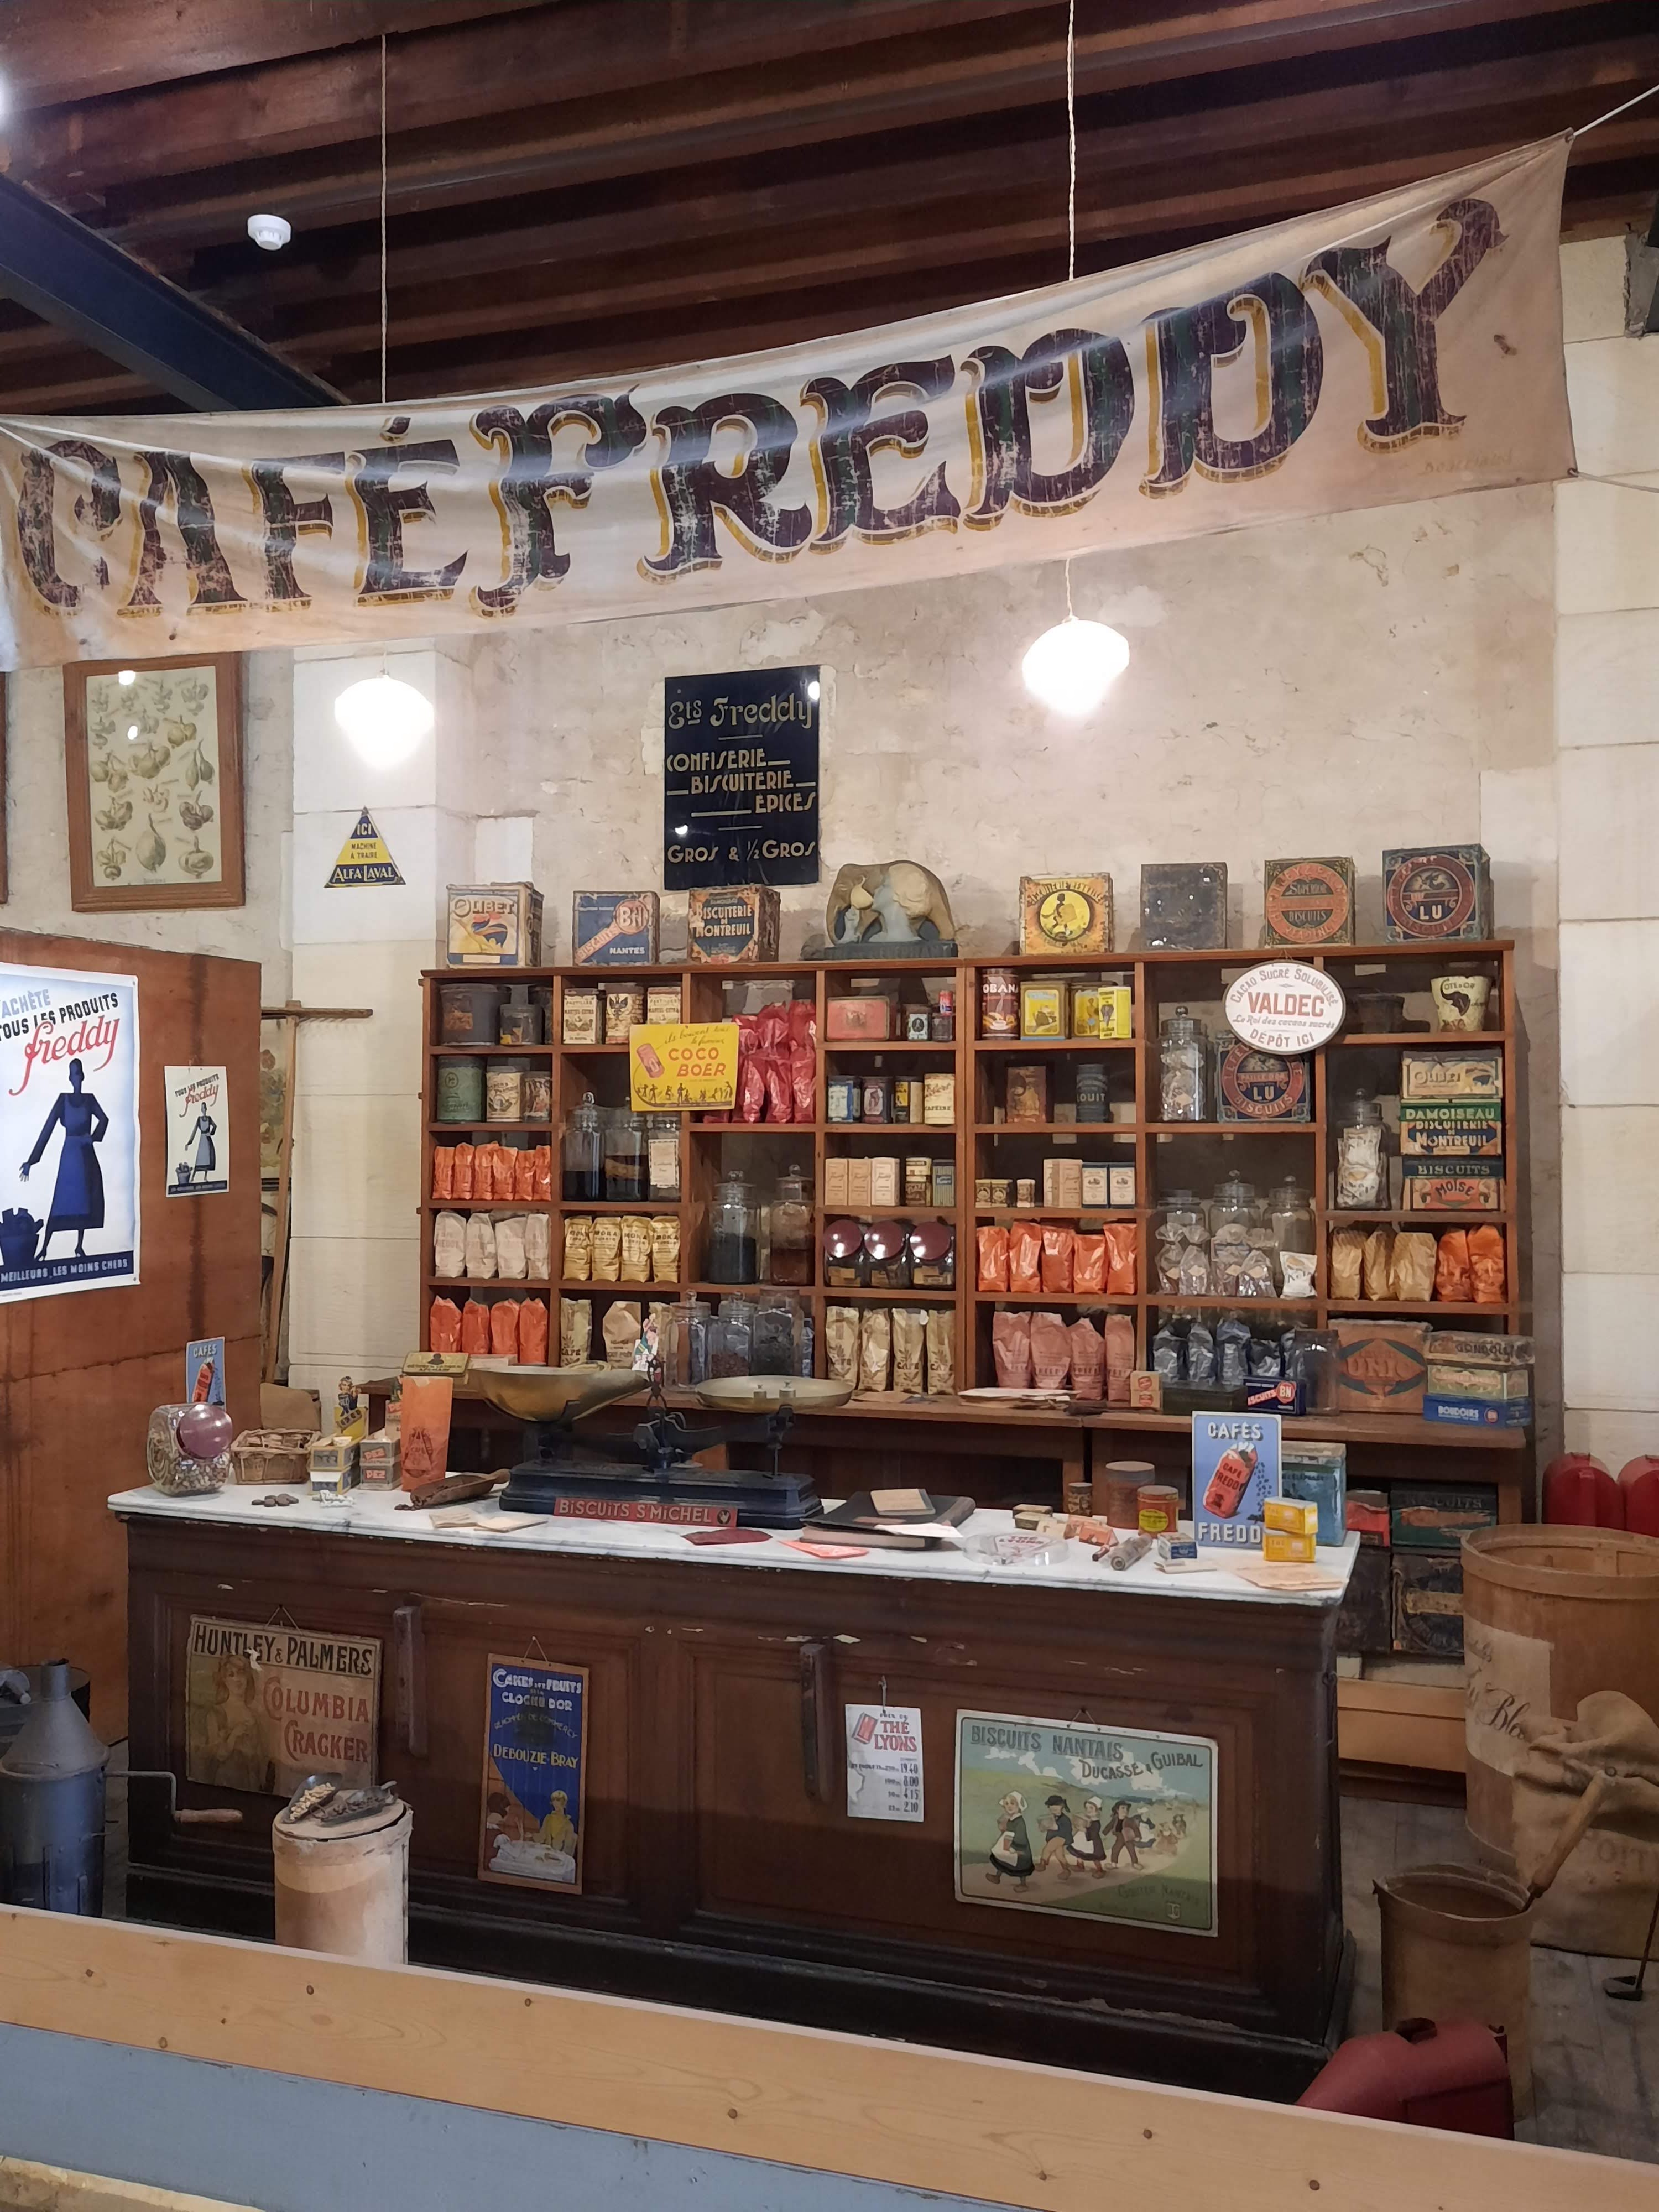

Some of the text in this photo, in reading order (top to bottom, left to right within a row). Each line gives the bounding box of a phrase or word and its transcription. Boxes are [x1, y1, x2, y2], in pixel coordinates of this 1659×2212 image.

[18, 197, 1509, 619] CAFÉ FREDDY
[709, 693, 812, 729] Freddy
[667, 748, 768, 772] CONFISERIE
[691, 770, 794, 794] BISCUITERIE
[357, 823, 372, 836] ICI
[728, 847, 740, 862] &
[1420, 905, 1442, 920] LU
[609, 946, 645, 954] NANTES
[1230, 977, 1257, 1003] CACAO
[59, 992, 118, 1023] PRODUITS
[1248, 992, 1324, 1018] VALDEC
[1261, 1016, 1276, 1025] des
[1250, 1029, 1314, 1047] DÉPÔT ICI
[668, 1047, 719, 1061] COCO
[676, 1062, 727, 1077] BOER
[1253, 1086, 1275, 1100] LU
[1234, 1094, 1293, 1115] BISCUITS
[1406, 1108, 1495, 1119] DAMOISEAU
[1416, 1132, 1487, 1147] MONTREUIL
[1417, 1165, 1490, 1175] BISCUITS
[53, 1266, 67, 1277] LES
[71, 1261, 100, 1274] MOINS
[1280, 1385, 1292, 1398] BN
[1438, 1405, 1479, 1416] BOUDOIRS
[1198, 1522, 1263, 1543] FREDD
[194, 1624, 276, 1662] HUNTLEY
[286, 1636, 373, 1676] PALMERS
[493, 1668, 534, 1688] CAKES
[546, 1678, 582, 1694] FRUITS
[263, 1676, 369, 1723] COLUMBIA
[284, 1719, 368, 1762] CRACKER
[874, 1734, 917, 1752] LYONS
[970, 1725, 1124, 1762] BISCUITS NANTAIS
[1079, 1759, 1144, 1779] DUCASSE
[1150, 1751, 1203, 1771] GUIBAL
